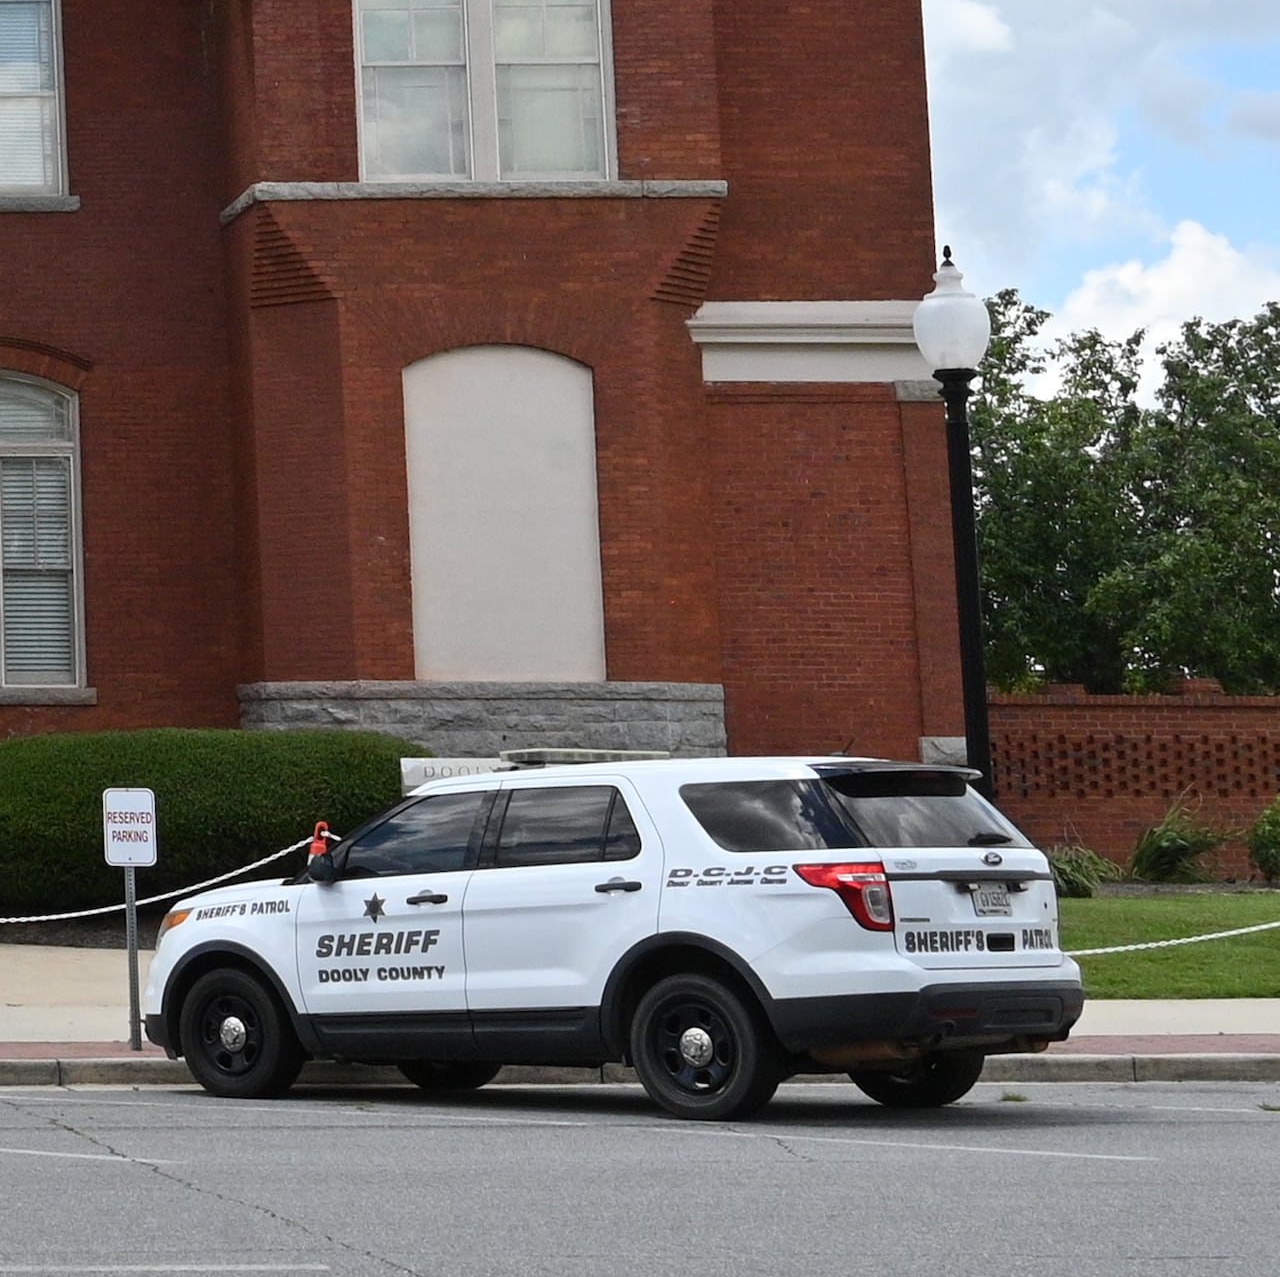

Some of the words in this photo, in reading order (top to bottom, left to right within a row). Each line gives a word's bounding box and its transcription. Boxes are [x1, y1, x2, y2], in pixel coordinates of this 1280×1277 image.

[107, 812, 152, 824] RESERVED
[112, 830, 149, 843] PARKING
[196, 903, 247, 922] SHERIFF'S
[250, 899, 291, 916] PATROL
[315, 929, 440, 959] SHERIFF
[905, 930, 985, 953] SHERIFF'S
[1022, 929, 1053, 949] PATROL
[318, 968, 371, 984] DOOLY
[377, 965, 446, 981] COUNTY
